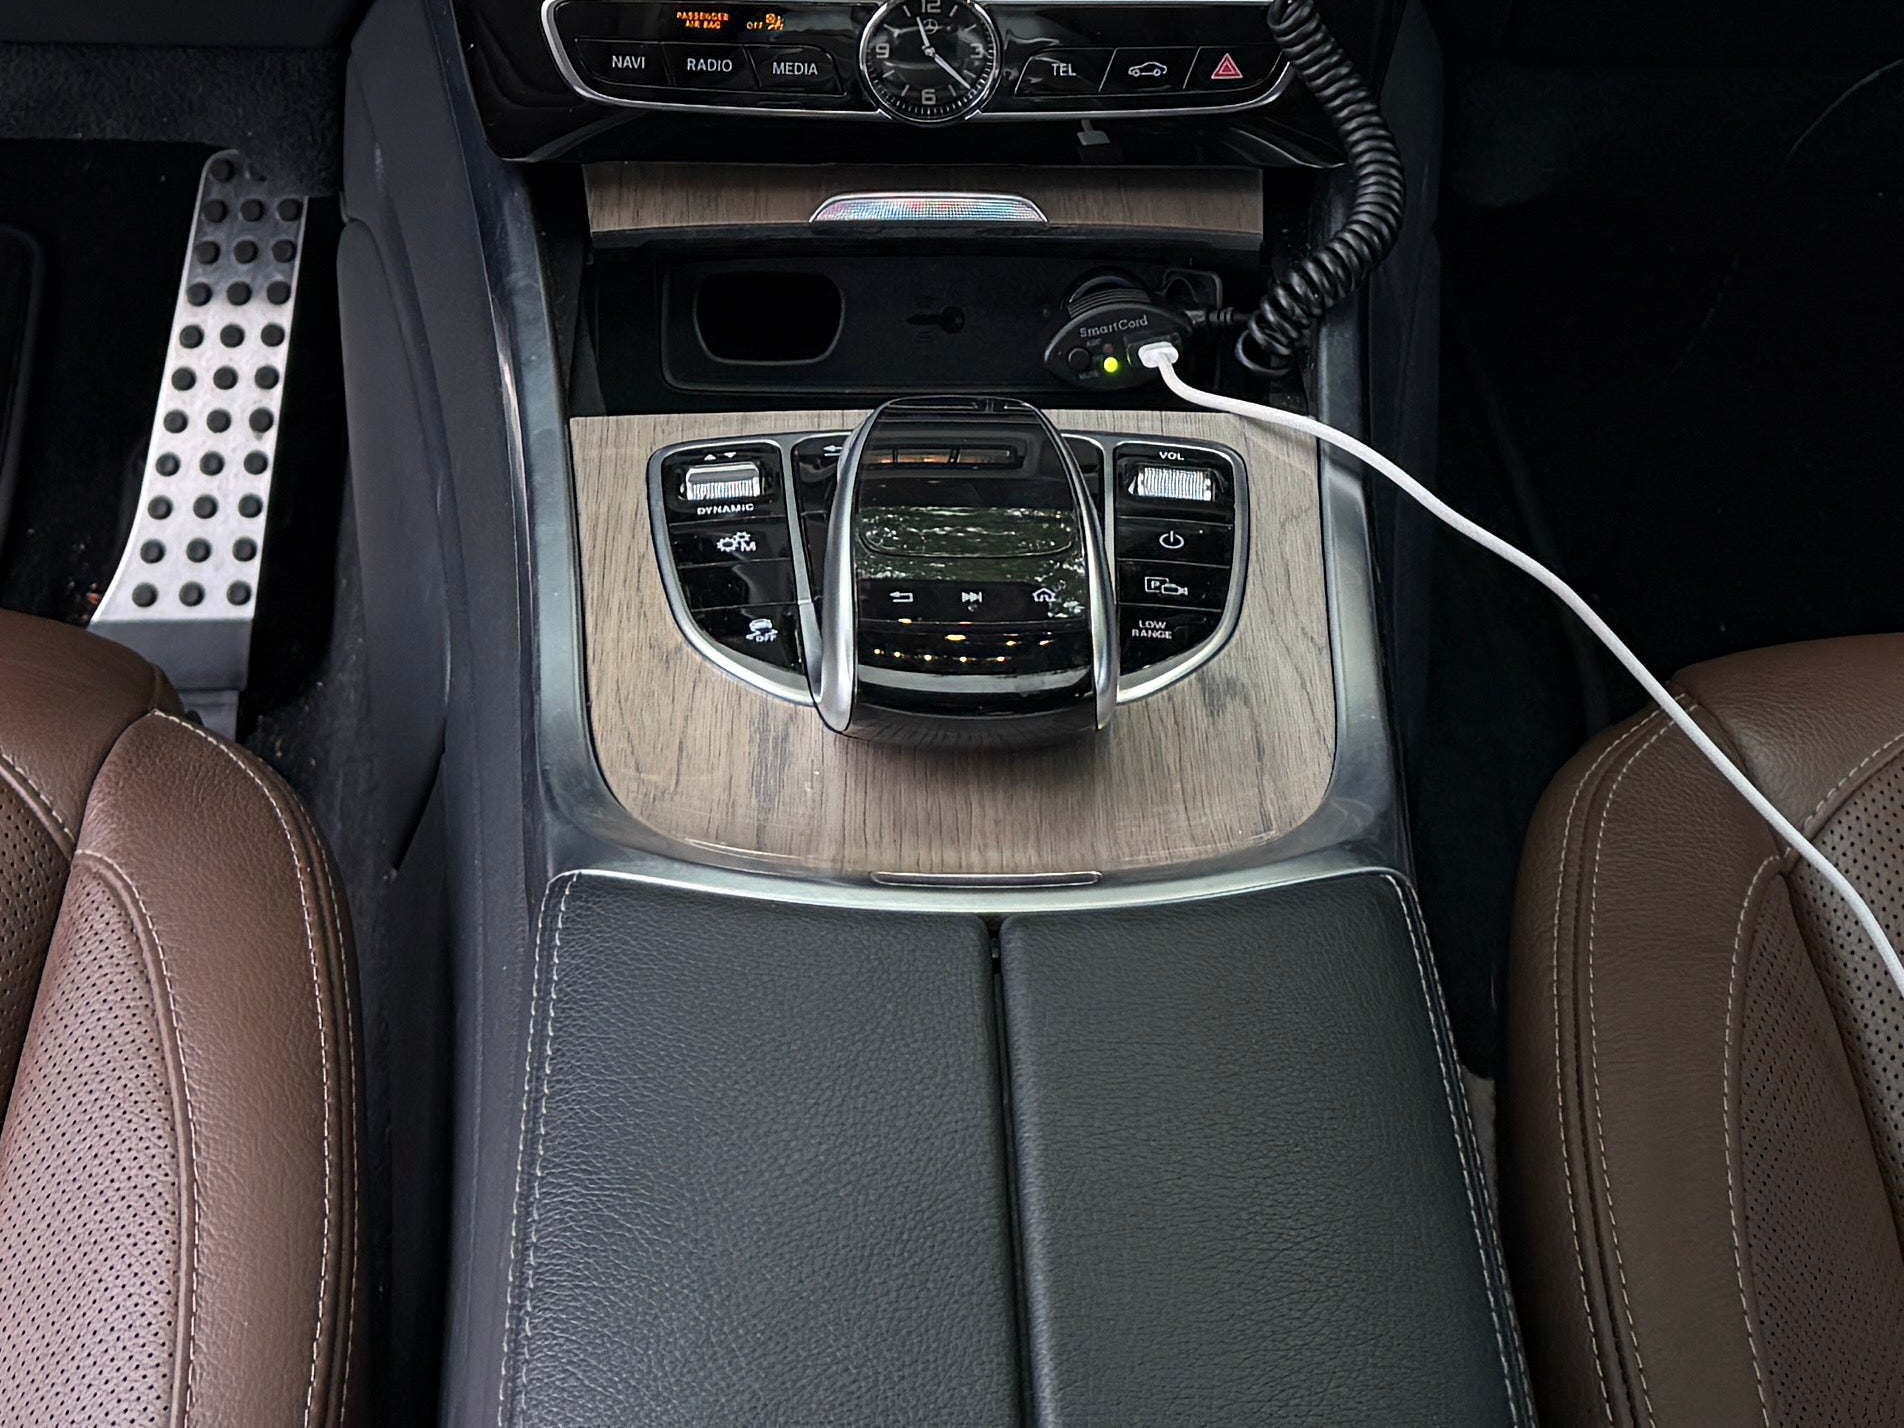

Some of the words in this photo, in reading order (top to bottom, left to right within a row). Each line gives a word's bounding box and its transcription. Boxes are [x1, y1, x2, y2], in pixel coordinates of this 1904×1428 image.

[676, 11, 729, 21] PASSENGER
[684, 20, 701, 29] AIR
[703, 20, 721, 30] BAG
[746, 21, 763, 30] OFF
[875, 43, 890, 59] 9
[970, 43, 984, 59] 3
[611, 55, 646, 69] NAVI
[686, 58, 733, 73] RADIO
[772, 62, 818, 76] MEDIA
[1051, 63, 1077, 77] TEL
[921, 89, 936, 105] 6
[1080, 315, 1149, 338] SmartCord
[1159, 450, 1185, 461] VOL
[697, 503, 755, 516] DYNAMIC
[1138, 619, 1167, 629] LOW
[755, 633, 777, 643] OFF
[1131, 628, 1173, 640] RANGE
